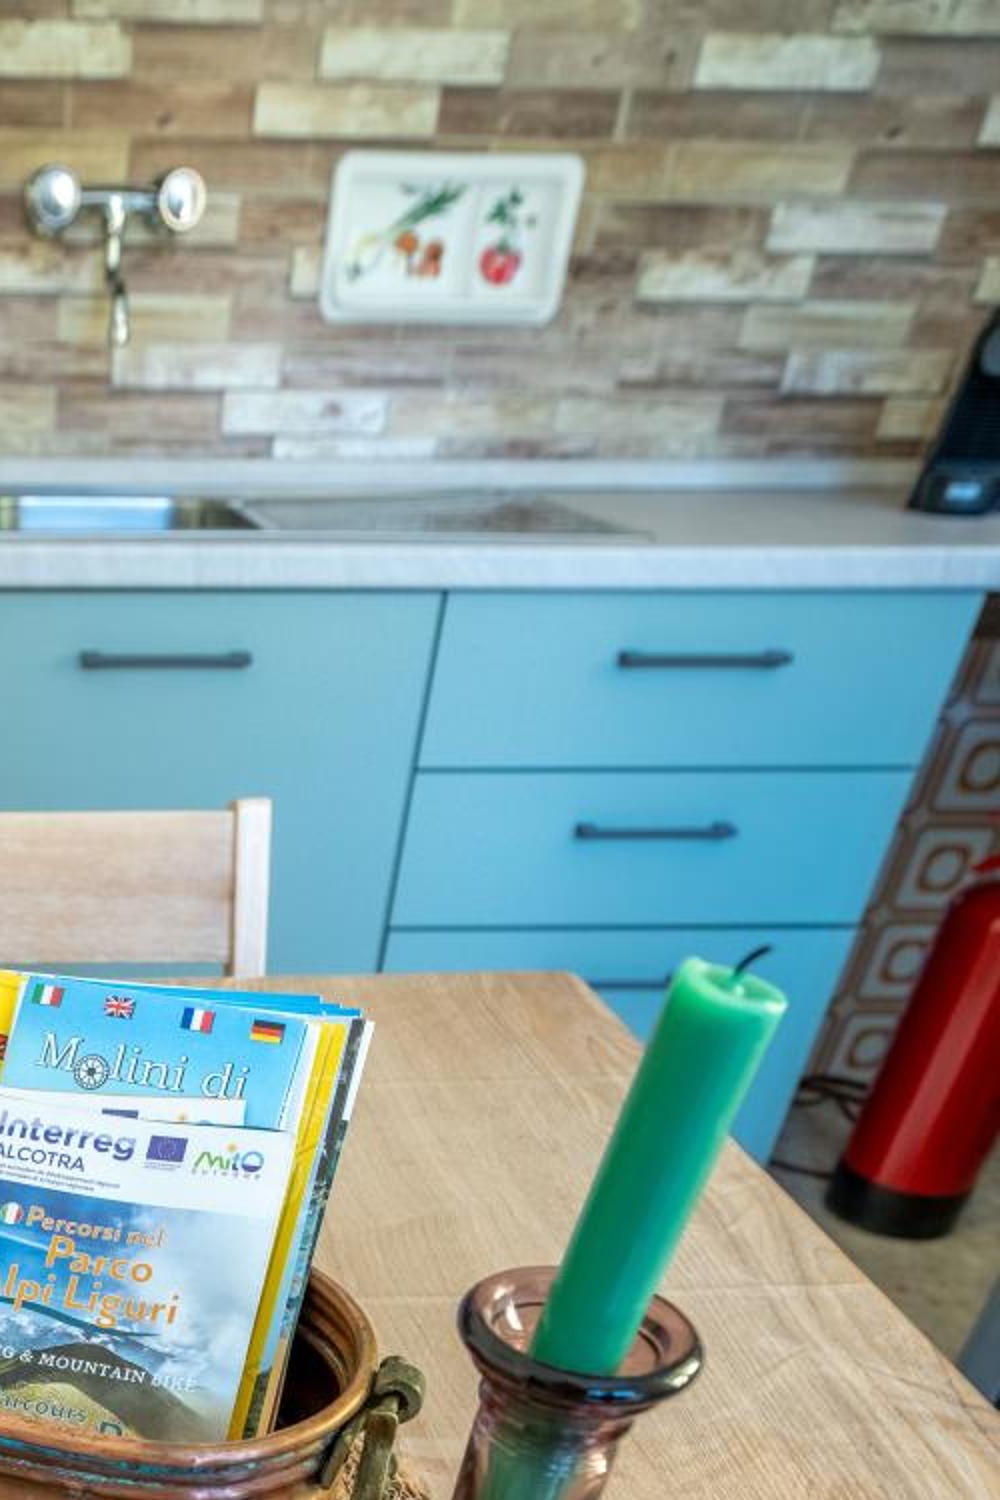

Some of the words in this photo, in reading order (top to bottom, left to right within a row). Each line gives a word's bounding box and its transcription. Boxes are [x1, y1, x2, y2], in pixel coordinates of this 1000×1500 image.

[35, 1031, 189, 1093] Molini
[200, 1061, 252, 1100] di
[24, 1204, 121, 1243] Percorsi
[43, 1234, 154, 1283] Parco
[63, 1274, 182, 1329] Liguri
[37, 1352, 147, 1385] MOUNTAIN
[150, 1373, 201, 1394] BIKE
